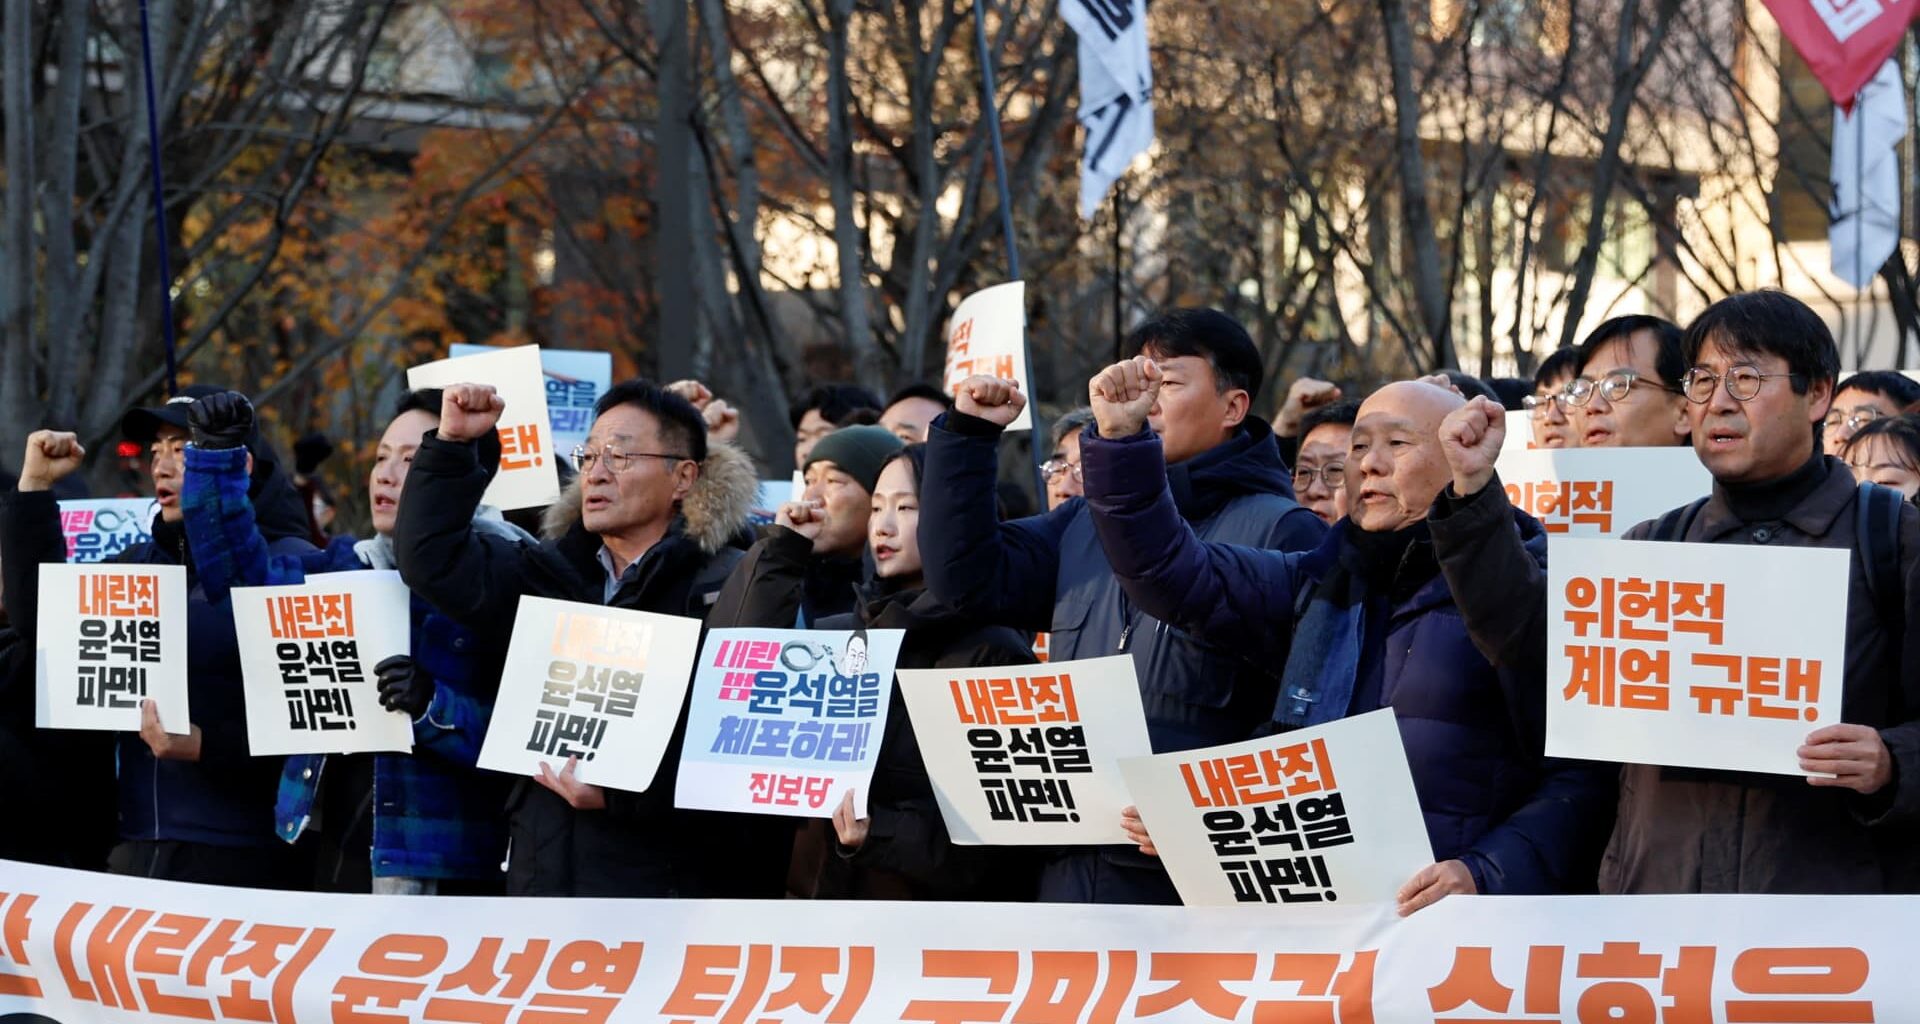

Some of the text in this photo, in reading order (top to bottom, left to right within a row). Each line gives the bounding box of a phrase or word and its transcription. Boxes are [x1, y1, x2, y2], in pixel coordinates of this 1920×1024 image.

[79, 575, 159, 617] 내란죄
[266, 593, 354, 639] 내란죄
[1564, 577, 1725, 646] 위헌적
[78, 619, 161, 663] 윤석열
[276, 640, 365, 684] 윤석열
[713, 640, 781, 670] 내란
[76, 666, 148, 709] 파면!
[540, 660, 645, 718] 윤석열
[949, 674, 1080, 725] 내란죄
[1563, 645, 1822, 722] 계엄 규탄!
[285, 688, 357, 731] 파면!
[526, 709, 608, 762] 파면!
[710, 716, 871, 762] 체포하라!
[967, 725, 1093, 763] 윤석열
[749, 773, 833, 809] 진보당
[1179, 737, 1337, 807] 내란죄
[980, 779, 1080, 822] 파면!
[1202, 792, 1354, 856] 윤석열
[1220, 855, 1337, 904] 파면!
[53, 901, 336, 1024] 내란죄
[331, 933, 645, 1024] 윤석열
